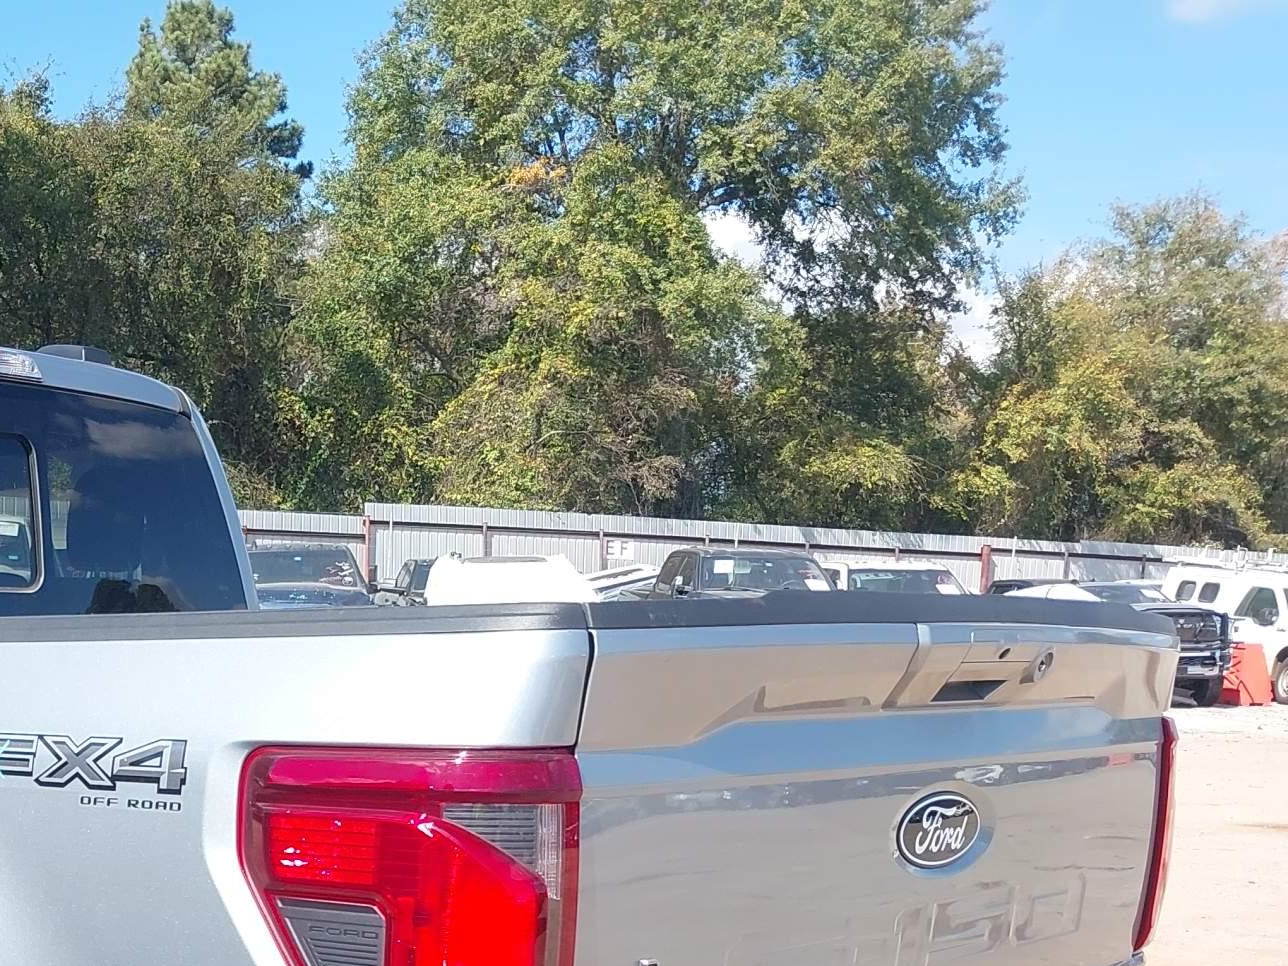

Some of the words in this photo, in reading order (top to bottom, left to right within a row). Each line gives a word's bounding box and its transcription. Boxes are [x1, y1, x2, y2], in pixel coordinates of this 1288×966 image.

[78, 795, 120, 807] OFF
[126, 799, 182, 812] ROAD
[914, 805, 970, 855] Ford
[308, 925, 379, 940] FORD
